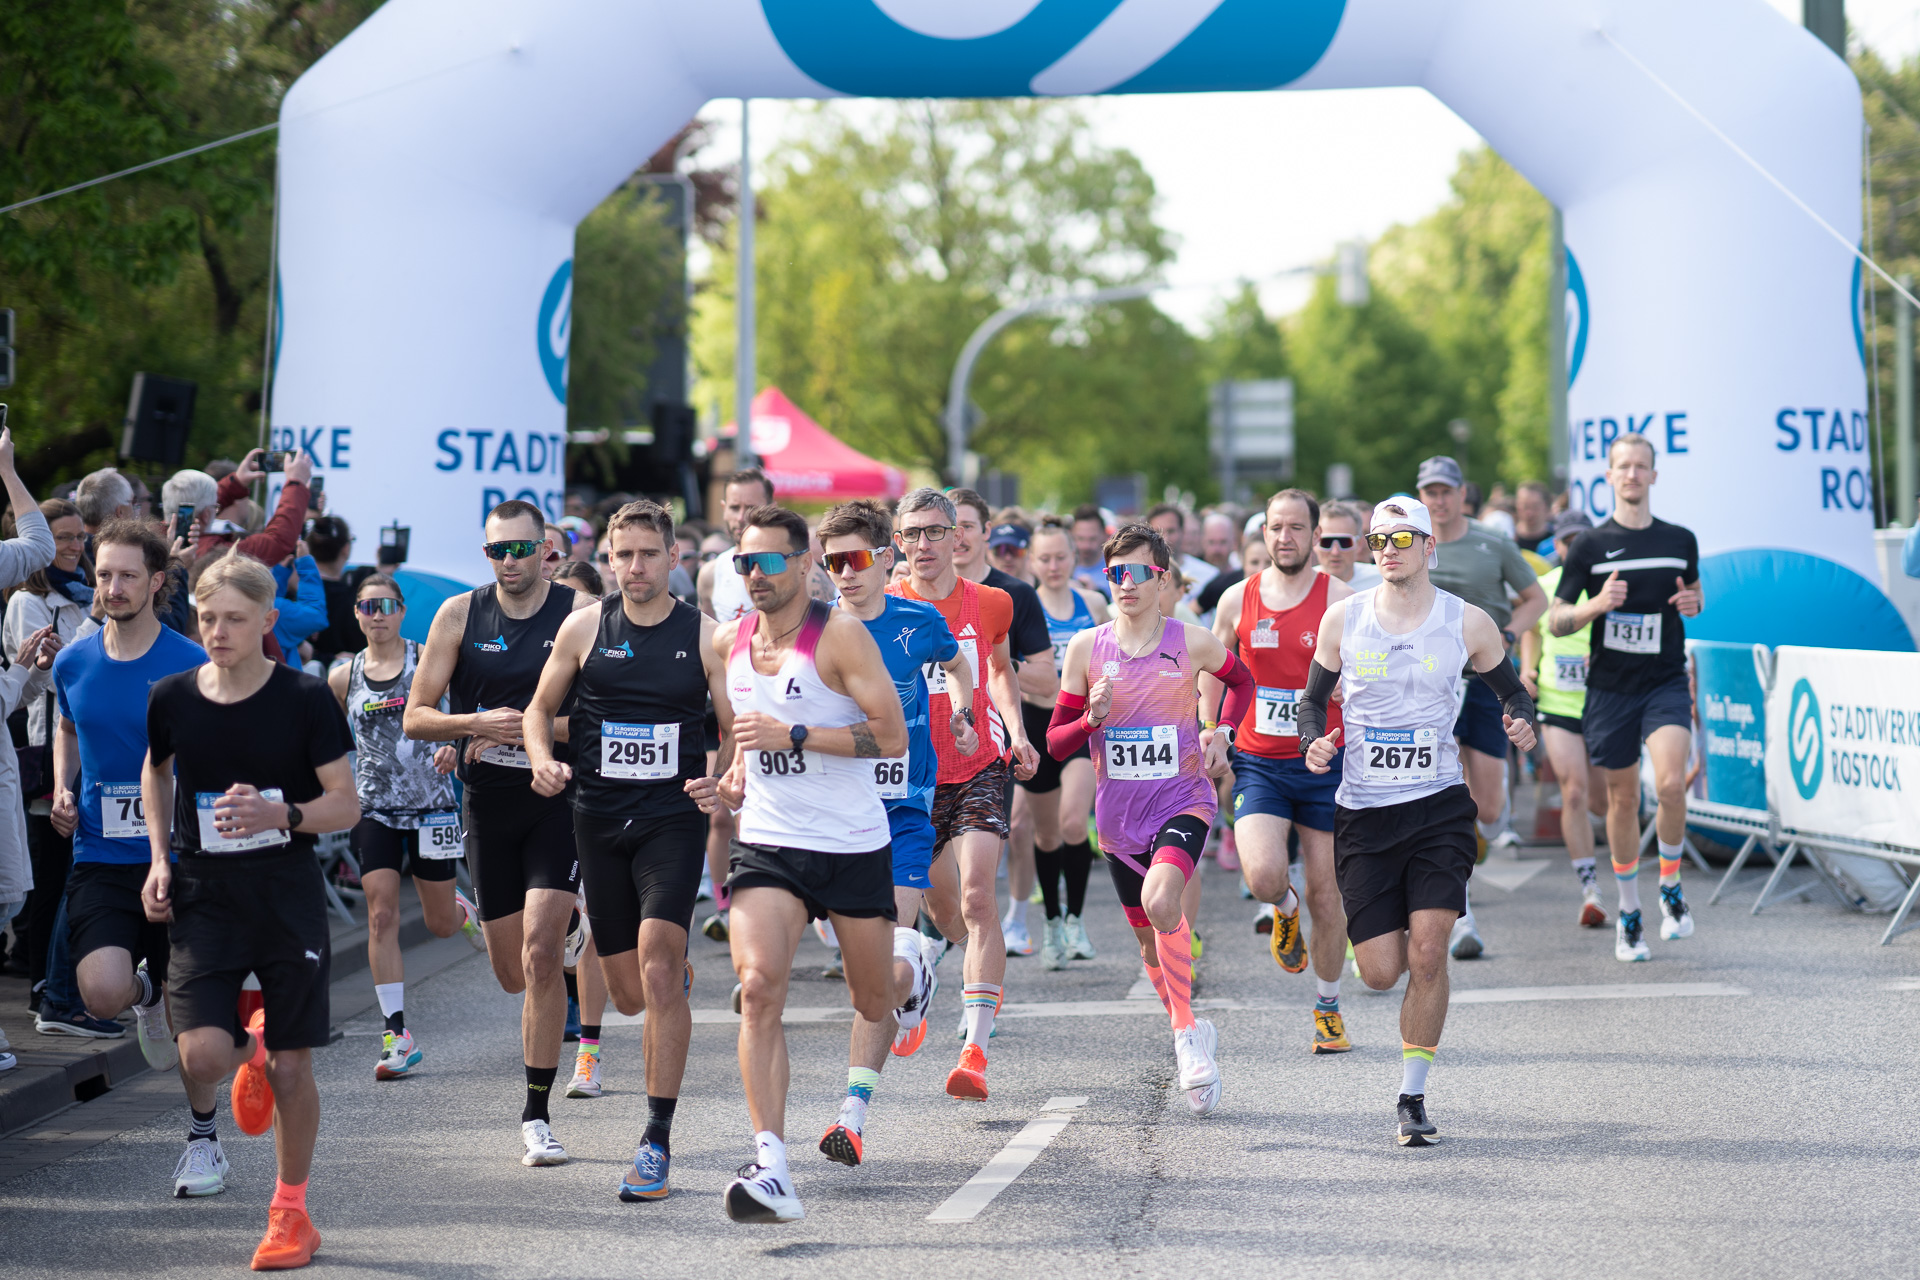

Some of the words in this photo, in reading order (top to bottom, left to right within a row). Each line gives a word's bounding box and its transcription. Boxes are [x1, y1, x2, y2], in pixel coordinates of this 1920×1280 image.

[1612, 622, 1654, 641] 1311
[497, 750, 516, 758] Jonas
[608, 740, 669, 765] 2951
[759, 750, 806, 775] 903
[1112, 743, 1173, 766] 3144
[1370, 745, 1432, 769] 2675
[874, 762, 904, 785] 66
[1831, 751, 1902, 792] ROSTOCK
[431, 825, 461, 846] 598
